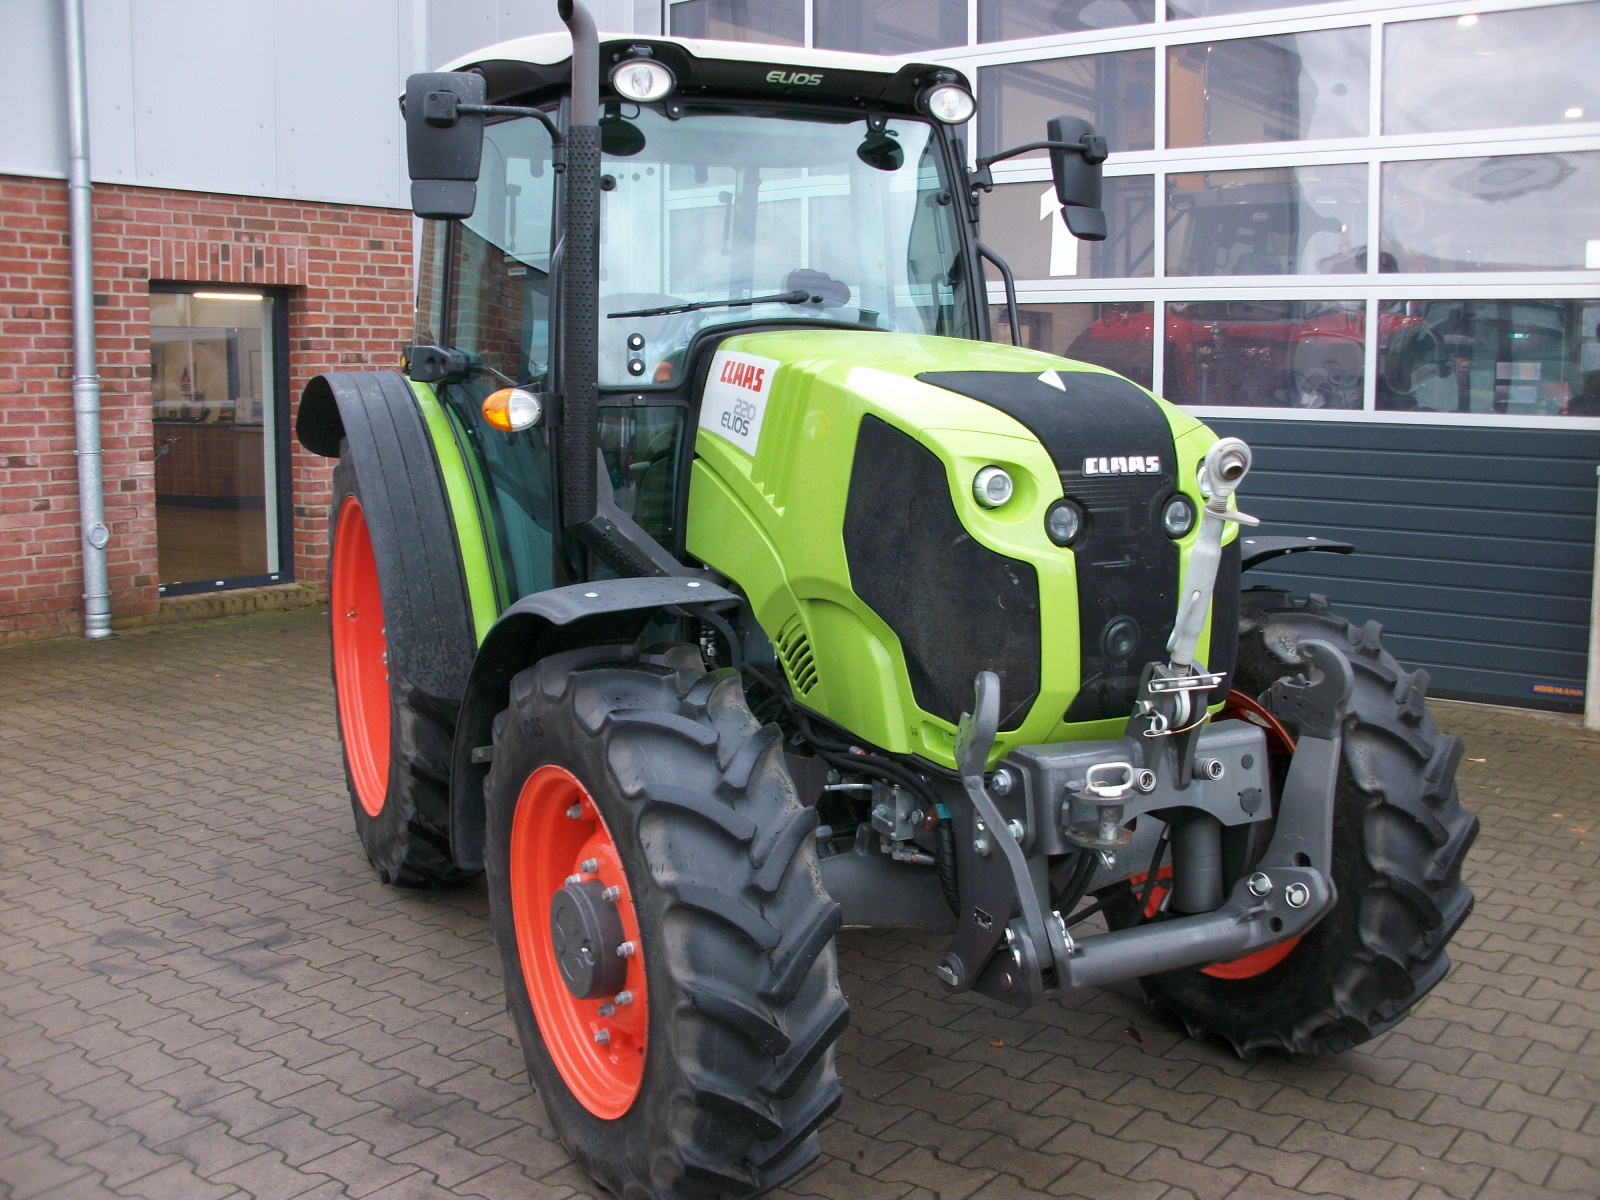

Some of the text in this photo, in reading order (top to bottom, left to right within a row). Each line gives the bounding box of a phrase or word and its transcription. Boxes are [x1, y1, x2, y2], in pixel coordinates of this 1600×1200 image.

[766, 70, 823, 86] ELIOS
[1040, 185, 1078, 277] 1
[720, 360, 765, 393] CLAAS
[733, 398, 757, 422] 220
[721, 411, 750, 437] ELIOS
[1084, 455, 1160, 475] CLAAS
